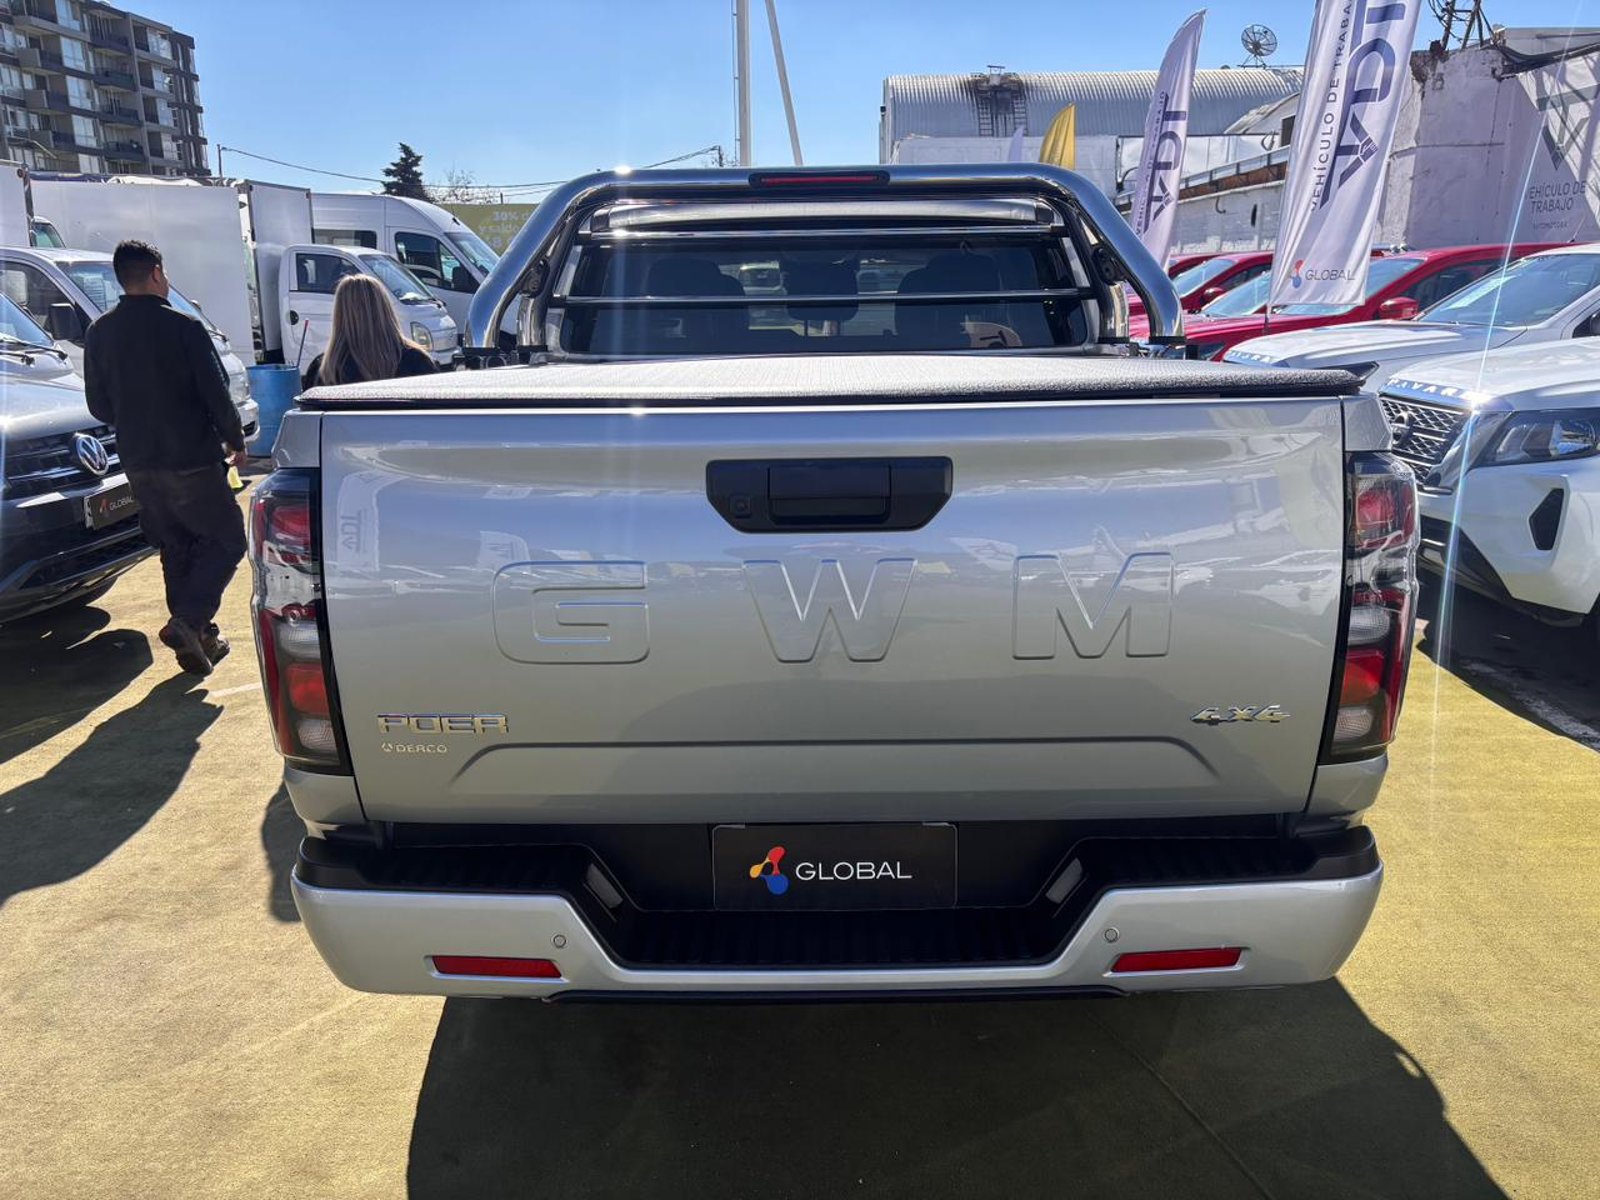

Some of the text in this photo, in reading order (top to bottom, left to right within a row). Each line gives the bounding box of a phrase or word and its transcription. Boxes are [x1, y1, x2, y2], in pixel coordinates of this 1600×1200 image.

[1332, 0, 1352, 72] TRABA
[1326, 77, 1341, 104] DE
[1527, 180, 1587, 199] EHÍCULO DE
[1531, 197, 1574, 212] TRABAJO
[1305, 269, 1356, 281] GLOBAL
[490, 552, 1174, 665] GWM
[377, 713, 509, 735] POER
[395, 743, 448, 754] DERCO
[795, 861, 913, 881] GLOBAL
